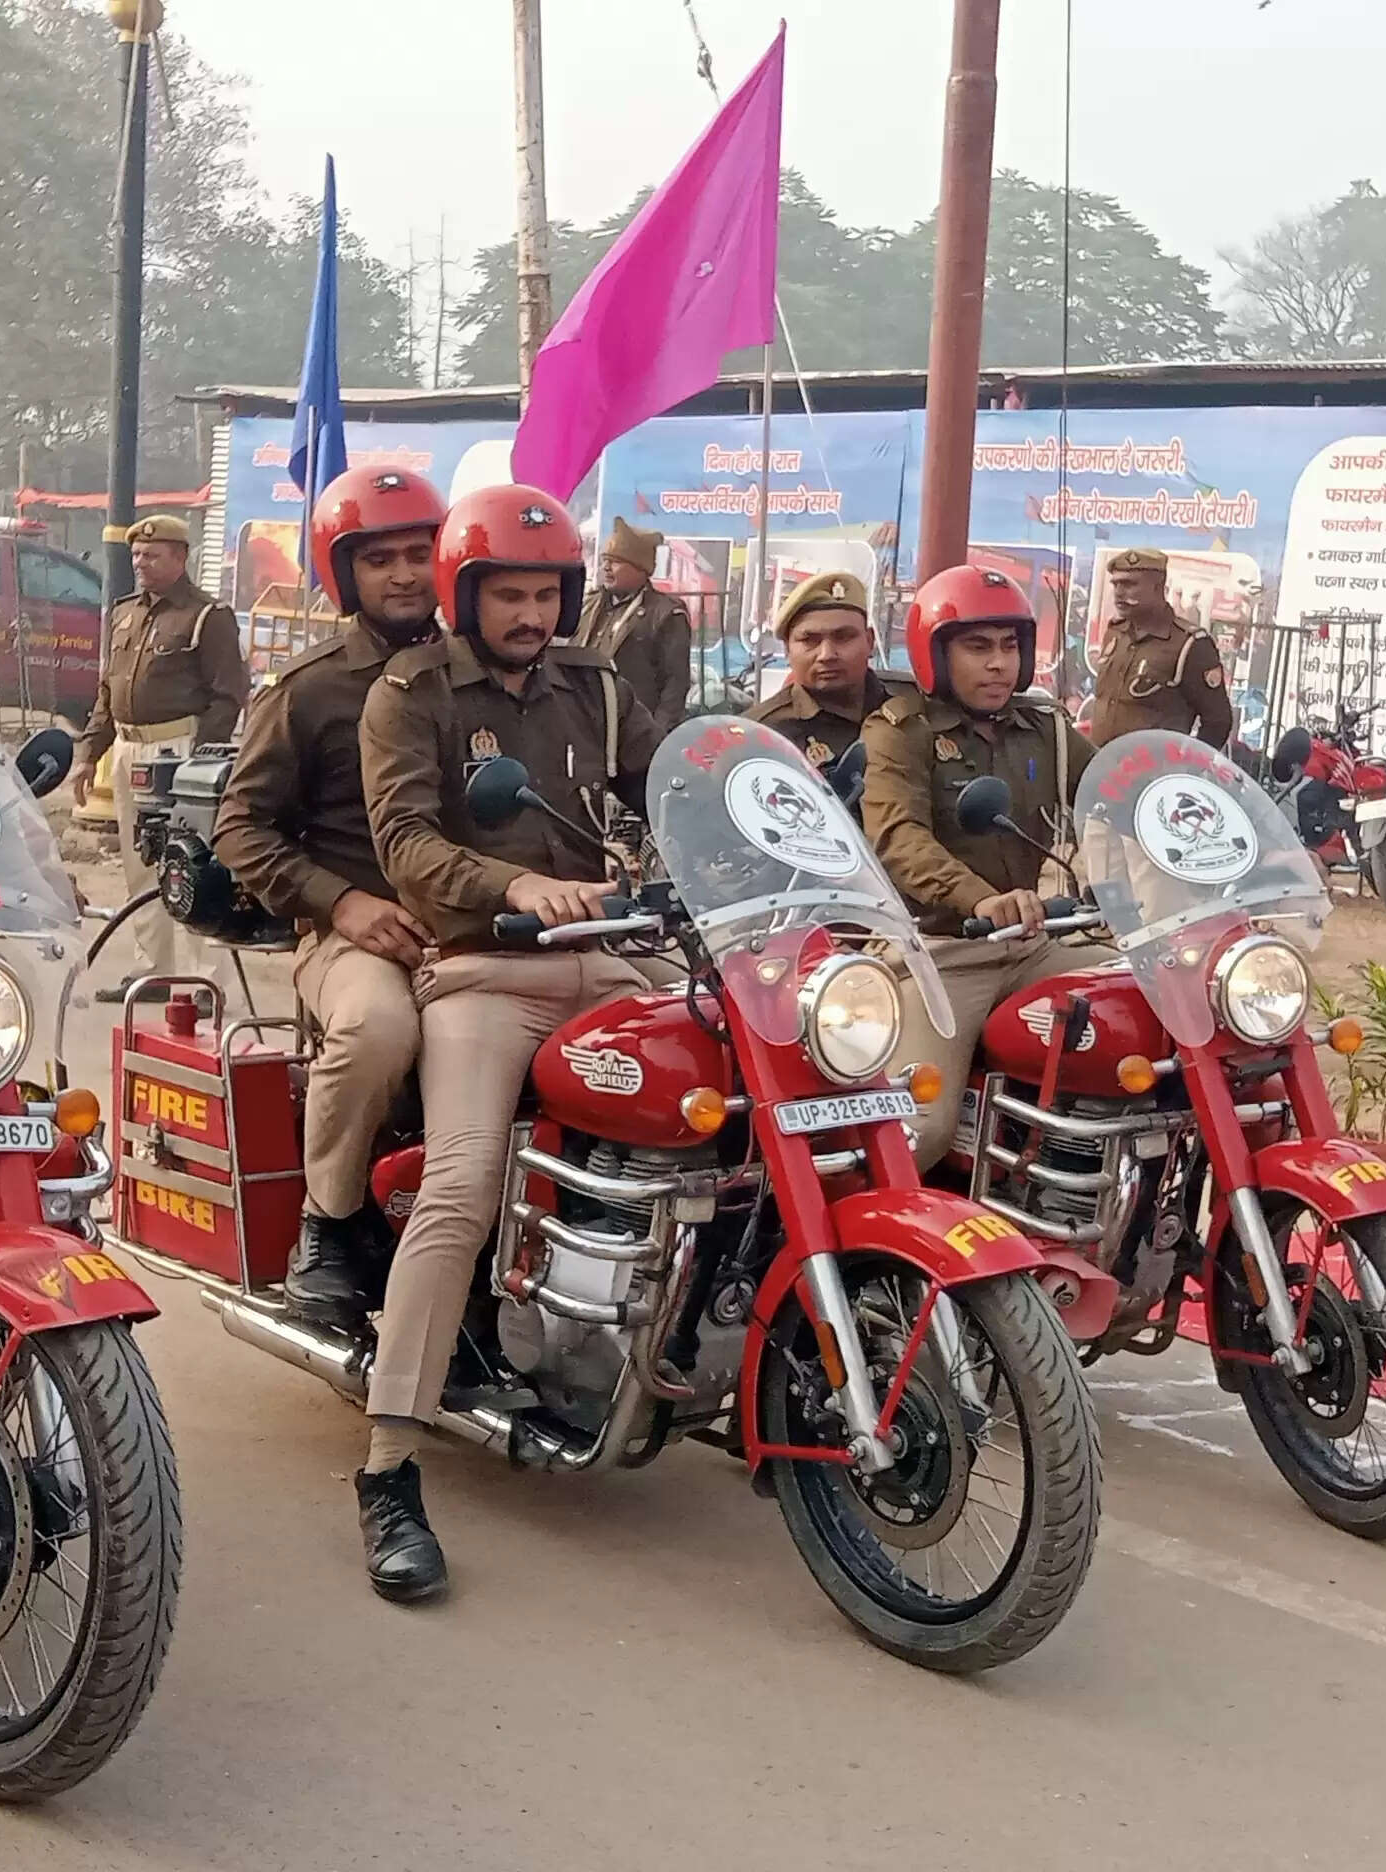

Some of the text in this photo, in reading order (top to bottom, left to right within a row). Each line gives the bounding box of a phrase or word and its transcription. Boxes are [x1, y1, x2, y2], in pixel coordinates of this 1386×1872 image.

[134, 1079, 207, 1130] FIRE
[136, 1181, 215, 1233] BIKE
[943, 1215, 1022, 1258] FIR
[37, 1253, 129, 1297] FIR
